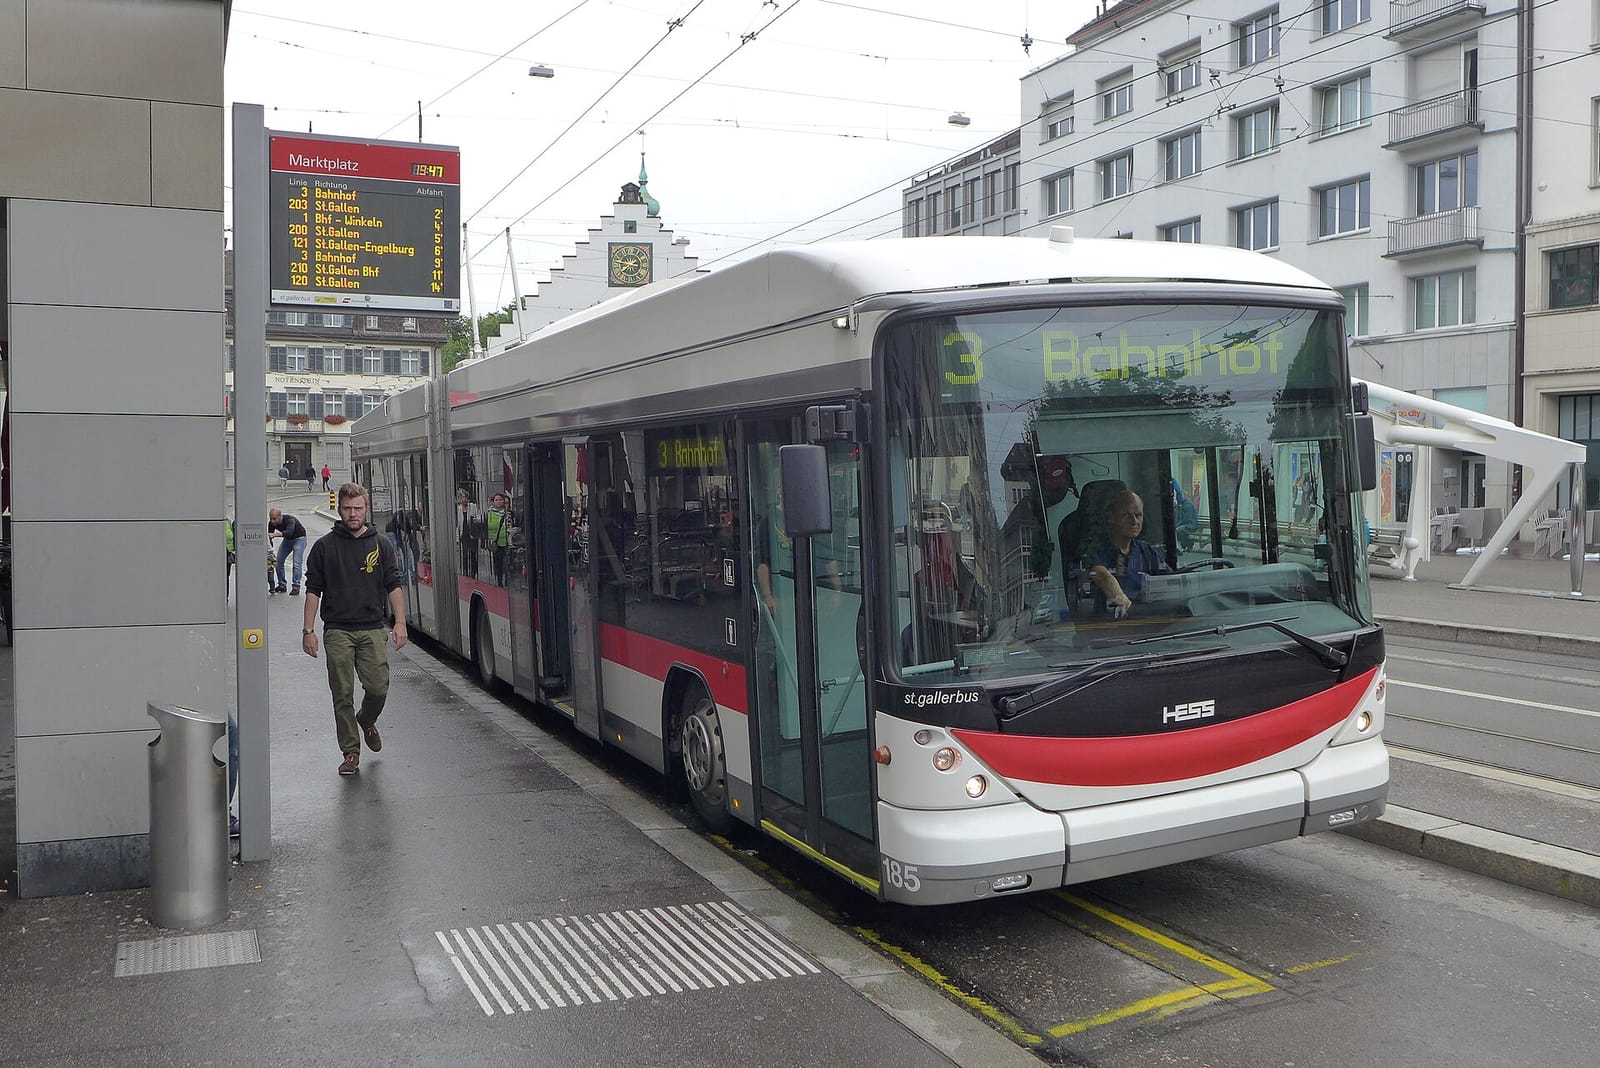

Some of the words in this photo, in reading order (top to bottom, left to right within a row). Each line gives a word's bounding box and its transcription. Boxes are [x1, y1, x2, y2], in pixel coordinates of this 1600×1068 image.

[289, 154, 358, 171] Marktplatz
[416, 165, 443, 177] 19:47
[302, 187, 308, 197] 3
[315, 188, 356, 200] Bahnhof
[315, 180, 347, 190] Richtung
[417, 188, 443, 196] Abfahrt
[289, 199, 308, 210] 203
[315, 201, 360, 214] St.Gallen
[303, 213, 308, 222] 1
[315, 214, 332, 223] Bhf
[345, 216, 383, 228] Winkeln
[289, 225, 308, 235] 200
[315, 226, 360, 238] St.Gallen
[293, 238, 308, 248] 121
[315, 239, 415, 257] St.Gallen-Engelburg
[302, 251, 308, 260] 3
[315, 252, 356, 263] Bahnhof
[291, 263, 308, 273] 210
[315, 264, 359, 276] St.Gallen
[363, 266, 379, 277] Bhf
[291, 275, 308, 286] 120
[315, 277, 360, 289] St.Gallen
[944, 332, 983, 385] 3
[1042, 327, 1283, 381] Bahnhof
[659, 440, 667, 467] 3
[675, 436, 719, 467] Bahnhof
[903, 690, 979, 708] st.gallerbus
[1162, 699, 1215, 724] HESS
[882, 857, 921, 892] 185
